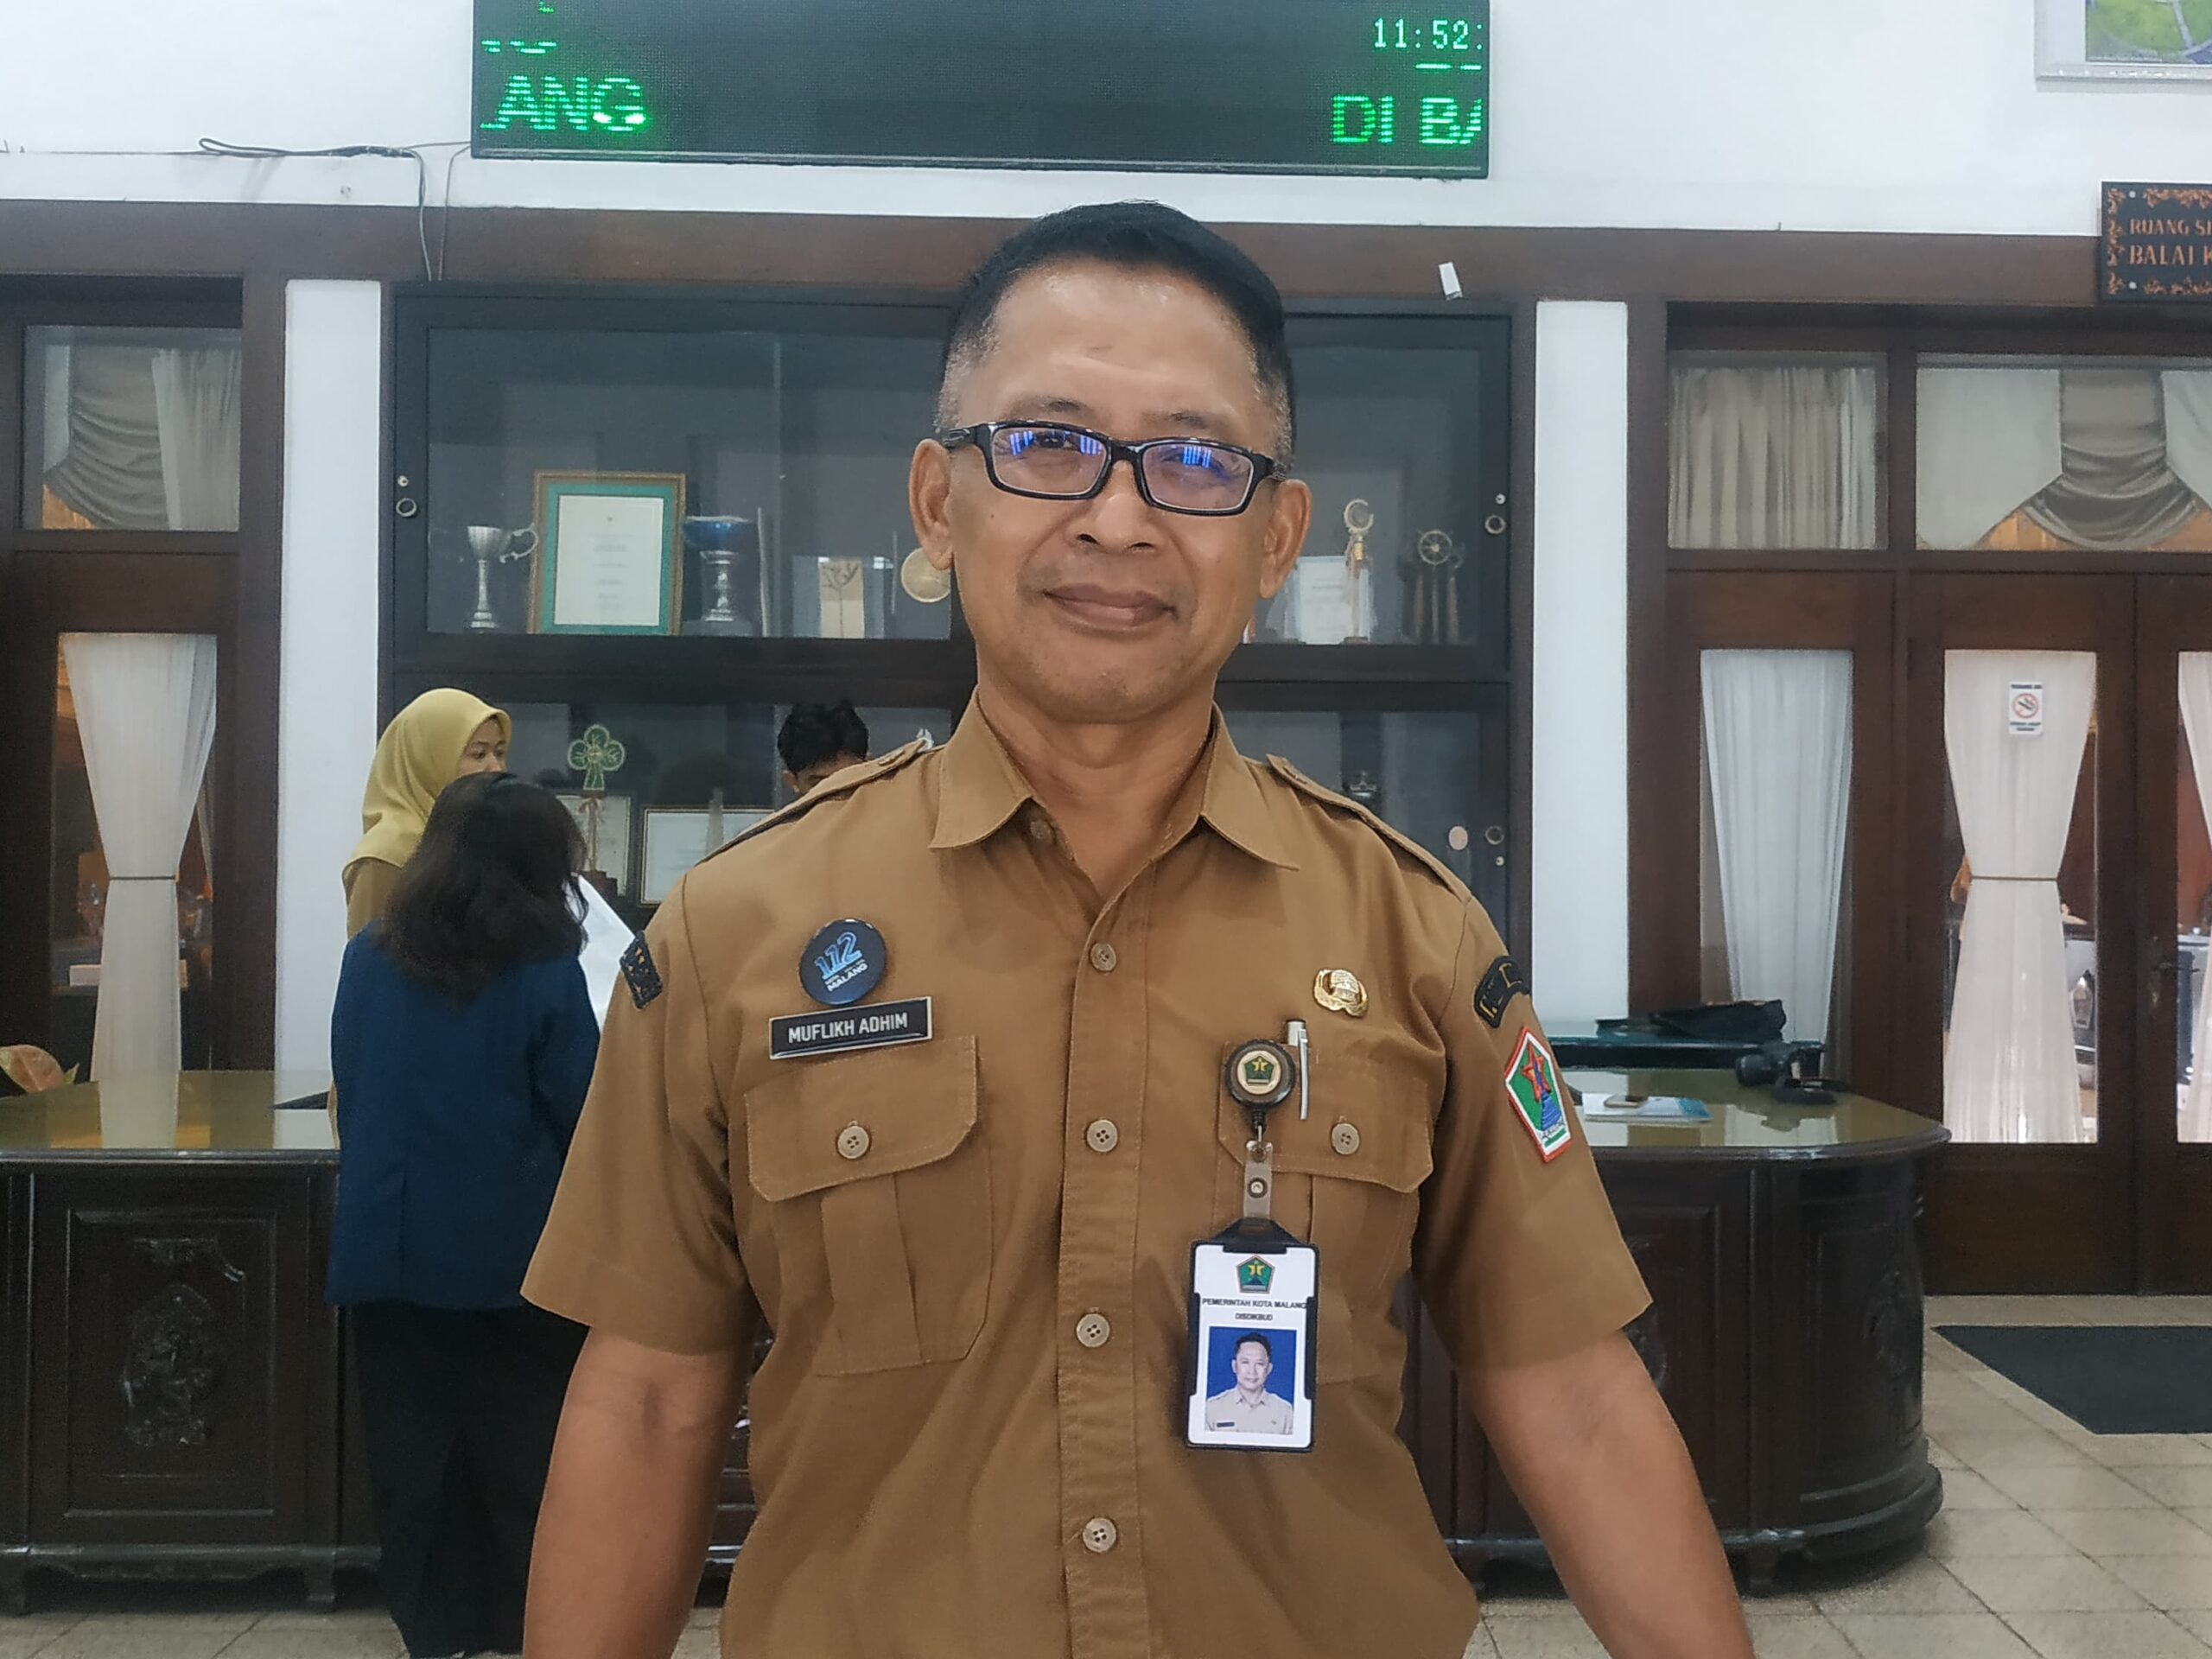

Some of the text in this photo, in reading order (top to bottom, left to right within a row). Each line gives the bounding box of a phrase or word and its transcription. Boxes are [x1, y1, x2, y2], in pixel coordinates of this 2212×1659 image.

[1332, 94, 1395, 144] DI
[2130, 219, 2190, 236] RUANG
[2129, 245, 2195, 266] BALAI
[814, 931, 863, 981] 112
[826, 962, 868, 992] MALANG
[788, 1012, 908, 1044] MUFLIKH ADHIM
[1201, 1298, 1251, 1307] PEMERINTAH
[1252, 1299, 1273, 1308] KOTA
